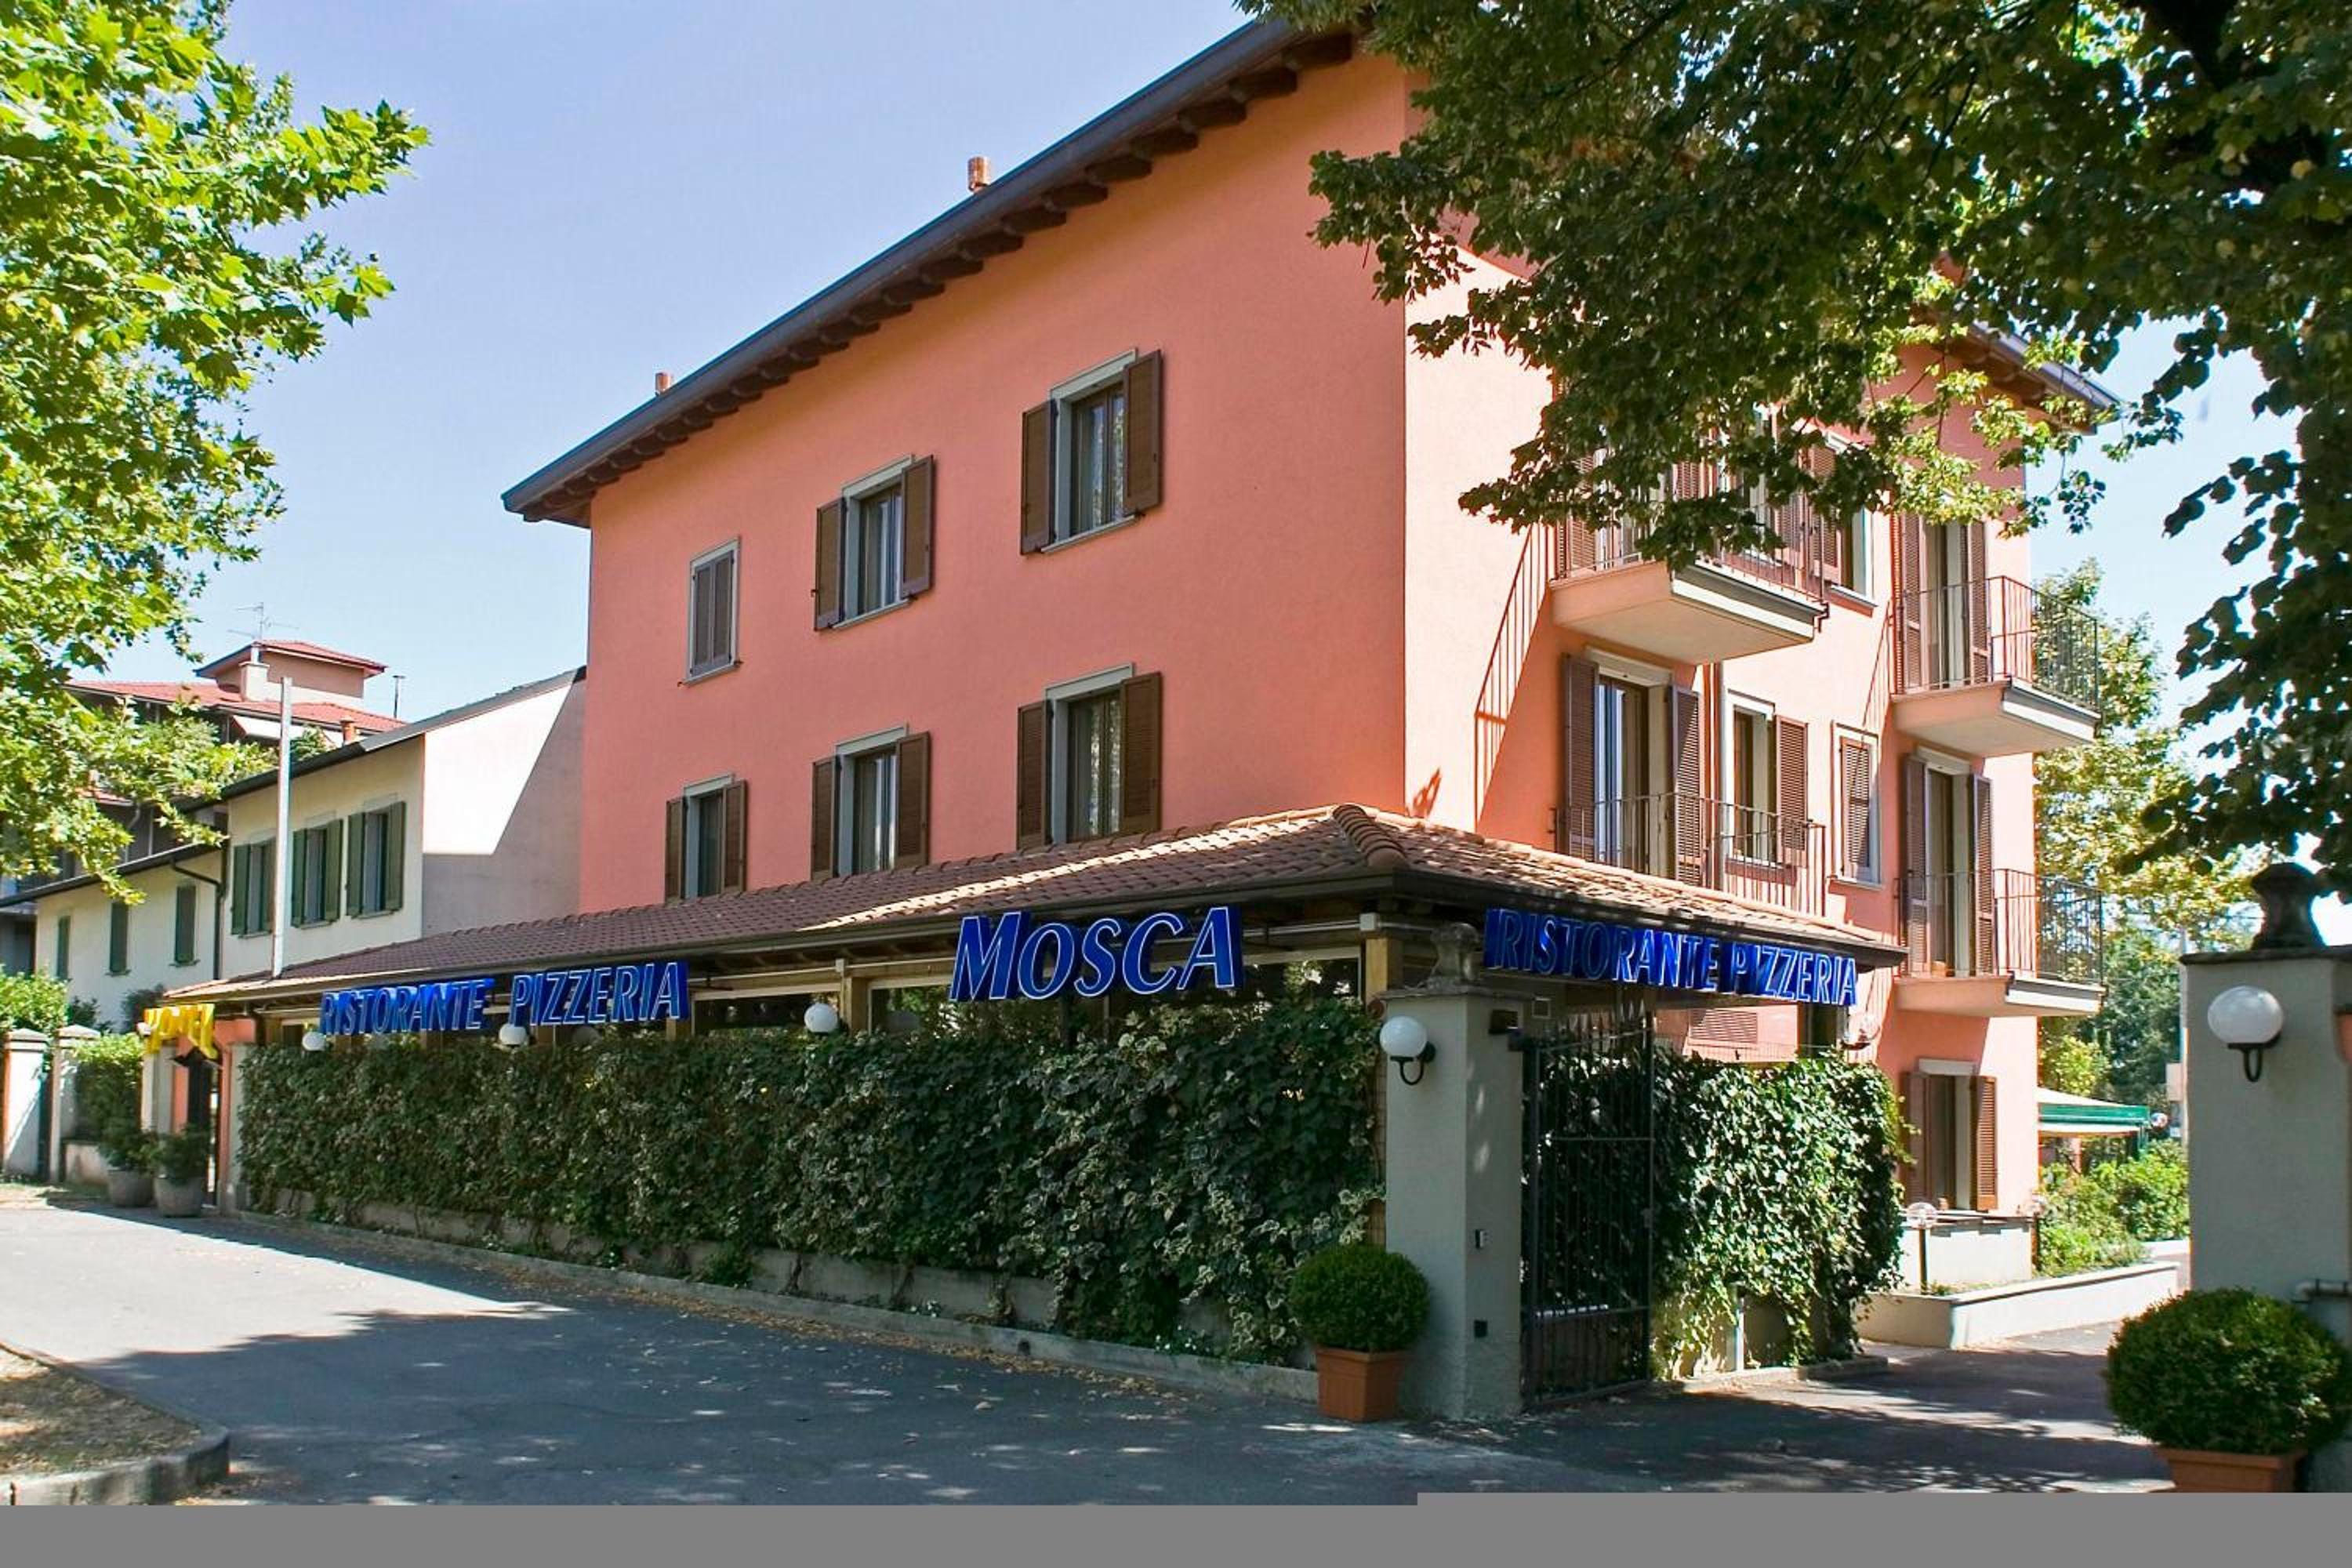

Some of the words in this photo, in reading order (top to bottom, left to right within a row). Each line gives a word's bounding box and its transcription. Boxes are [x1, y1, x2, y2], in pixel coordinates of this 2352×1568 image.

[321, 979, 488, 1035] RISTORANTE
[509, 962, 681, 1026] PIZZERIA
[949, 906, 1236, 1001] MOSCA
[1487, 909, 1719, 992] RISTORANTE
[1731, 942, 1857, 1005] PIZZERIA
